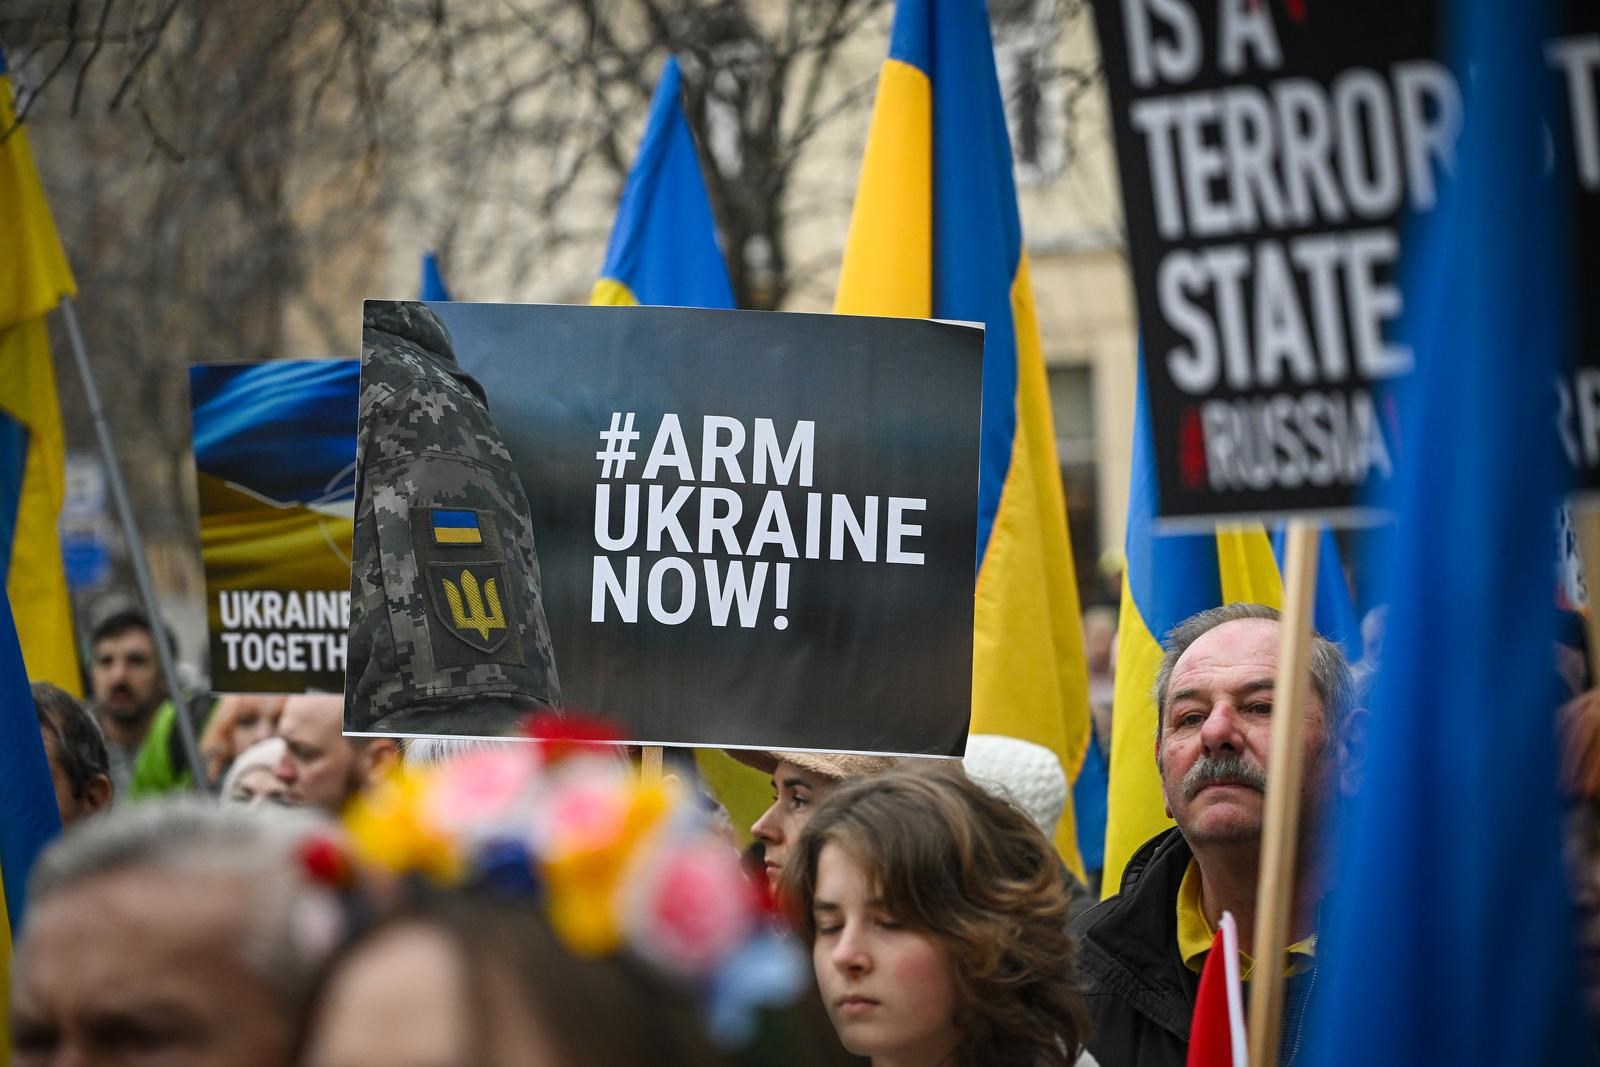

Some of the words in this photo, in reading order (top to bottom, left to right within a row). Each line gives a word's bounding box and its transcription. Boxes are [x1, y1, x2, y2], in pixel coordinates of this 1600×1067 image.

[1155, 230, 1416, 394] STATE
[595, 412, 816, 488] #ARM
[594, 483, 927, 566] UKRAINE
[590, 555, 791, 631] NOW!
[220, 632, 348, 672] TOGETH
